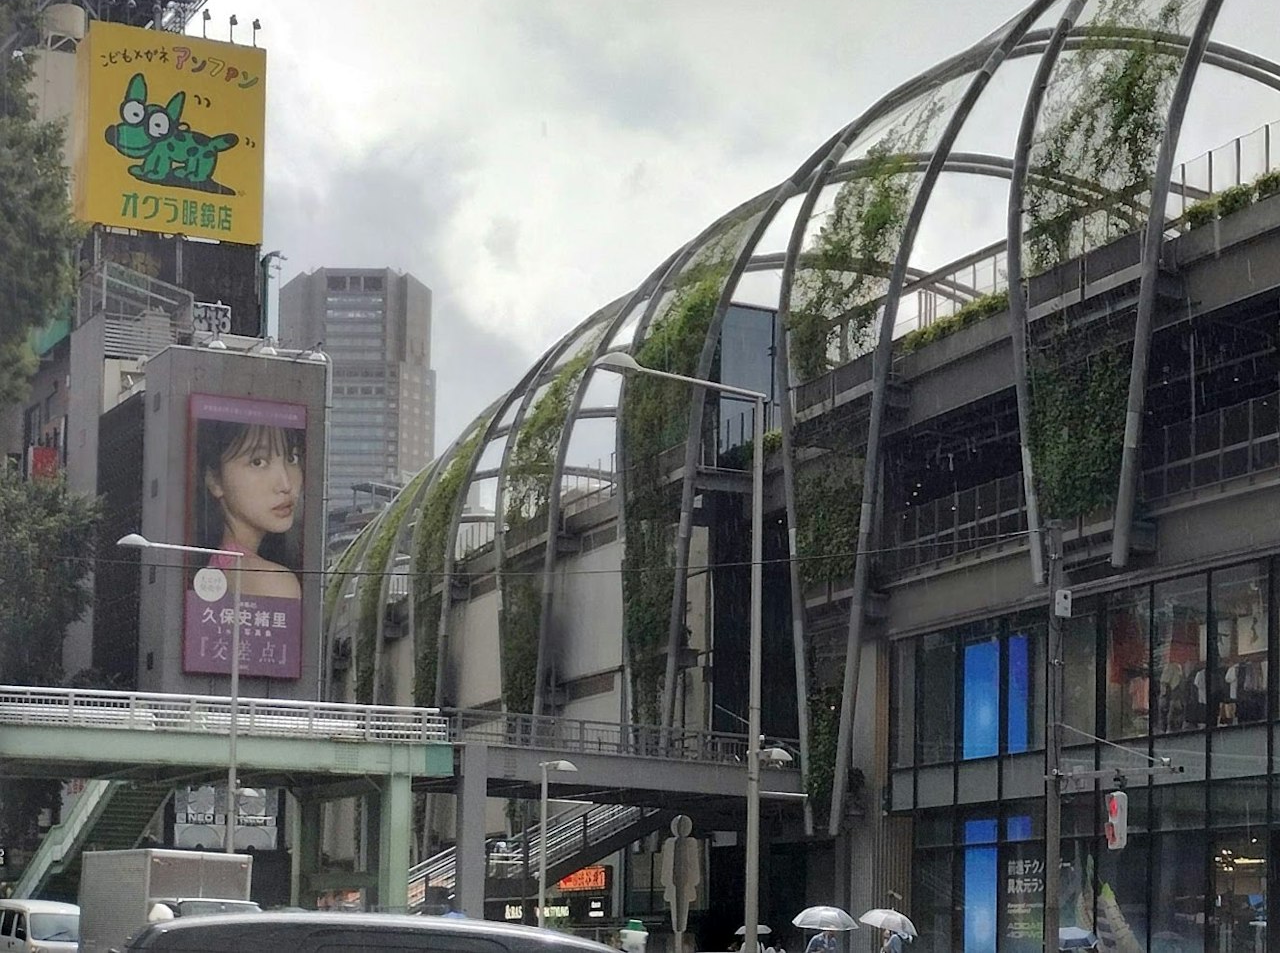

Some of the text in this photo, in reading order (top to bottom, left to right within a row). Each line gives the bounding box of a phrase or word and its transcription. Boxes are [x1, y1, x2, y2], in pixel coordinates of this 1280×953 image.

[121, 192, 233, 232] オグラ眼鏡店
[202, 607, 287, 628] 久保史緒里
